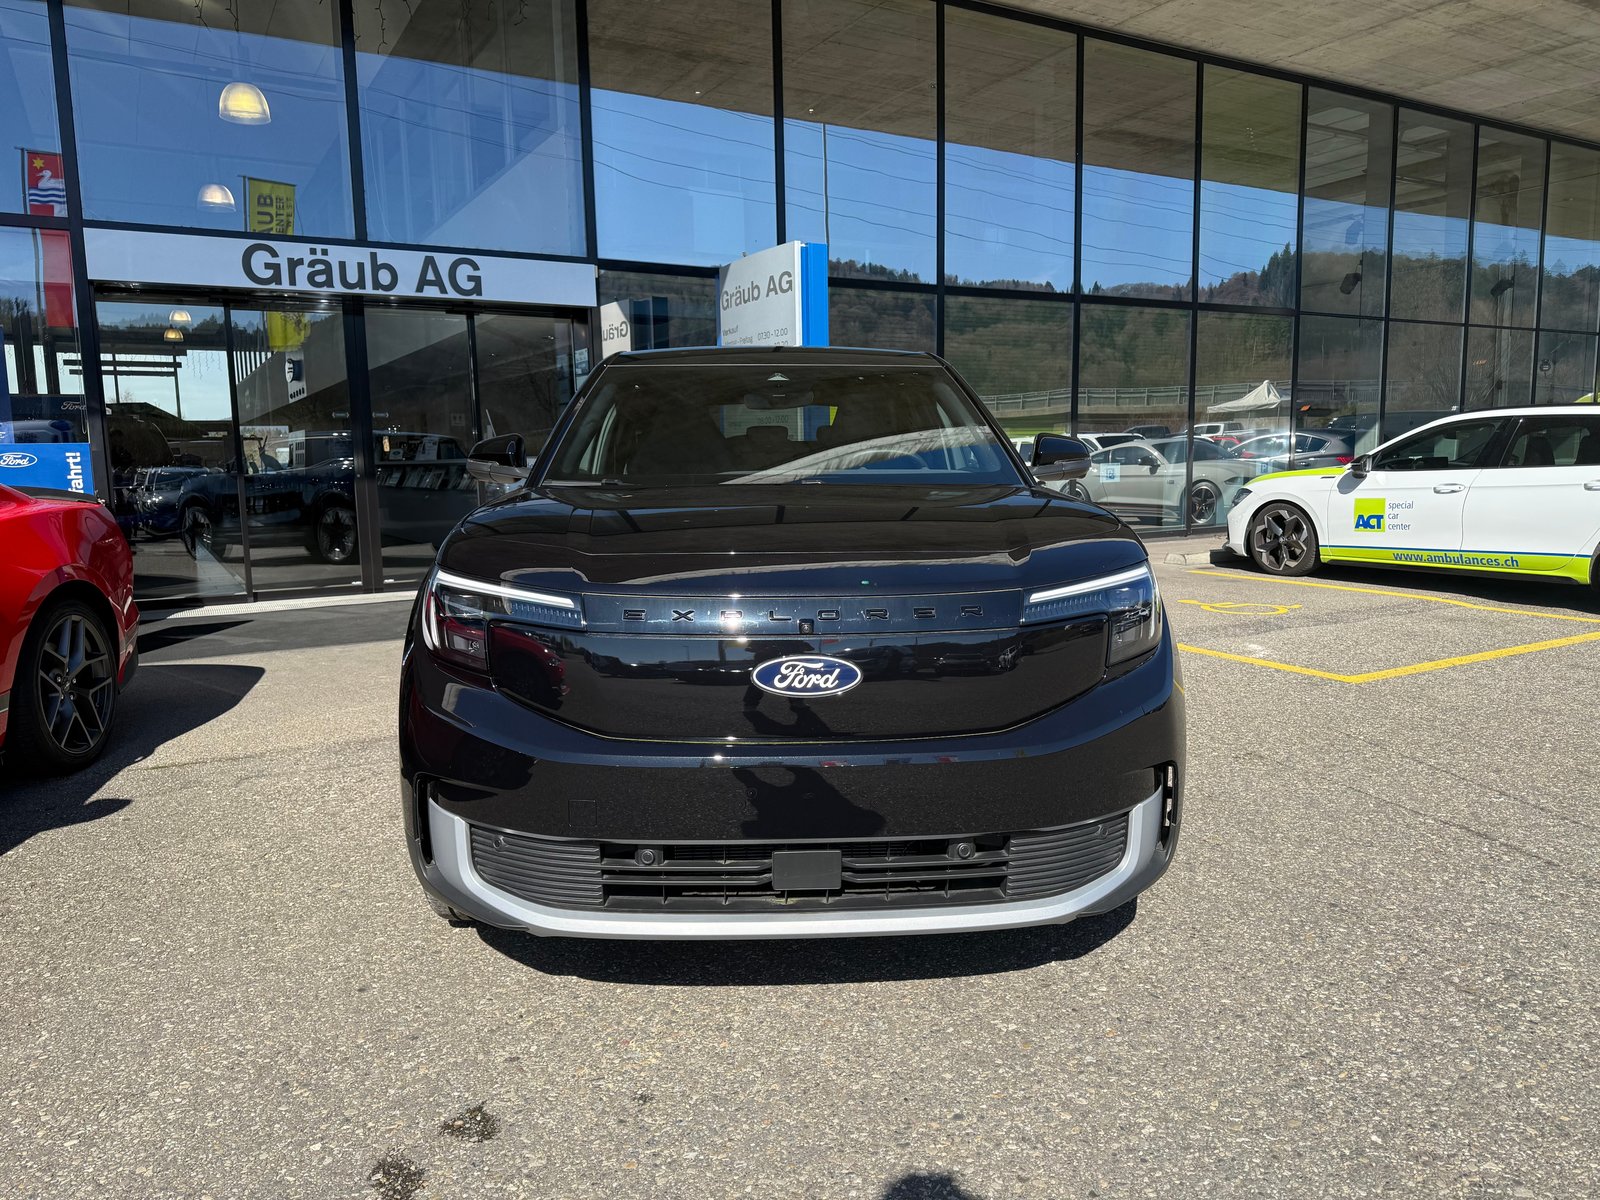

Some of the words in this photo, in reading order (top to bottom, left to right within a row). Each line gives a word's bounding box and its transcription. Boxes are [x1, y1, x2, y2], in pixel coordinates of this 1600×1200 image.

[241, 243, 399, 292] Gräub
[415, 255, 483, 297] AG
[721, 280, 761, 311] Gräub
[766, 270, 793, 298] AG
[0, 454, 30, 465] Ford
[1388, 501, 1414, 511] special
[1355, 514, 1384, 530] ACT
[1388, 523, 1411, 531] center
[1392, 552, 1519, 567] www.ambulances.ch
[622, 605, 984, 622] EXPLORER
[773, 661, 841, 689] Ford
